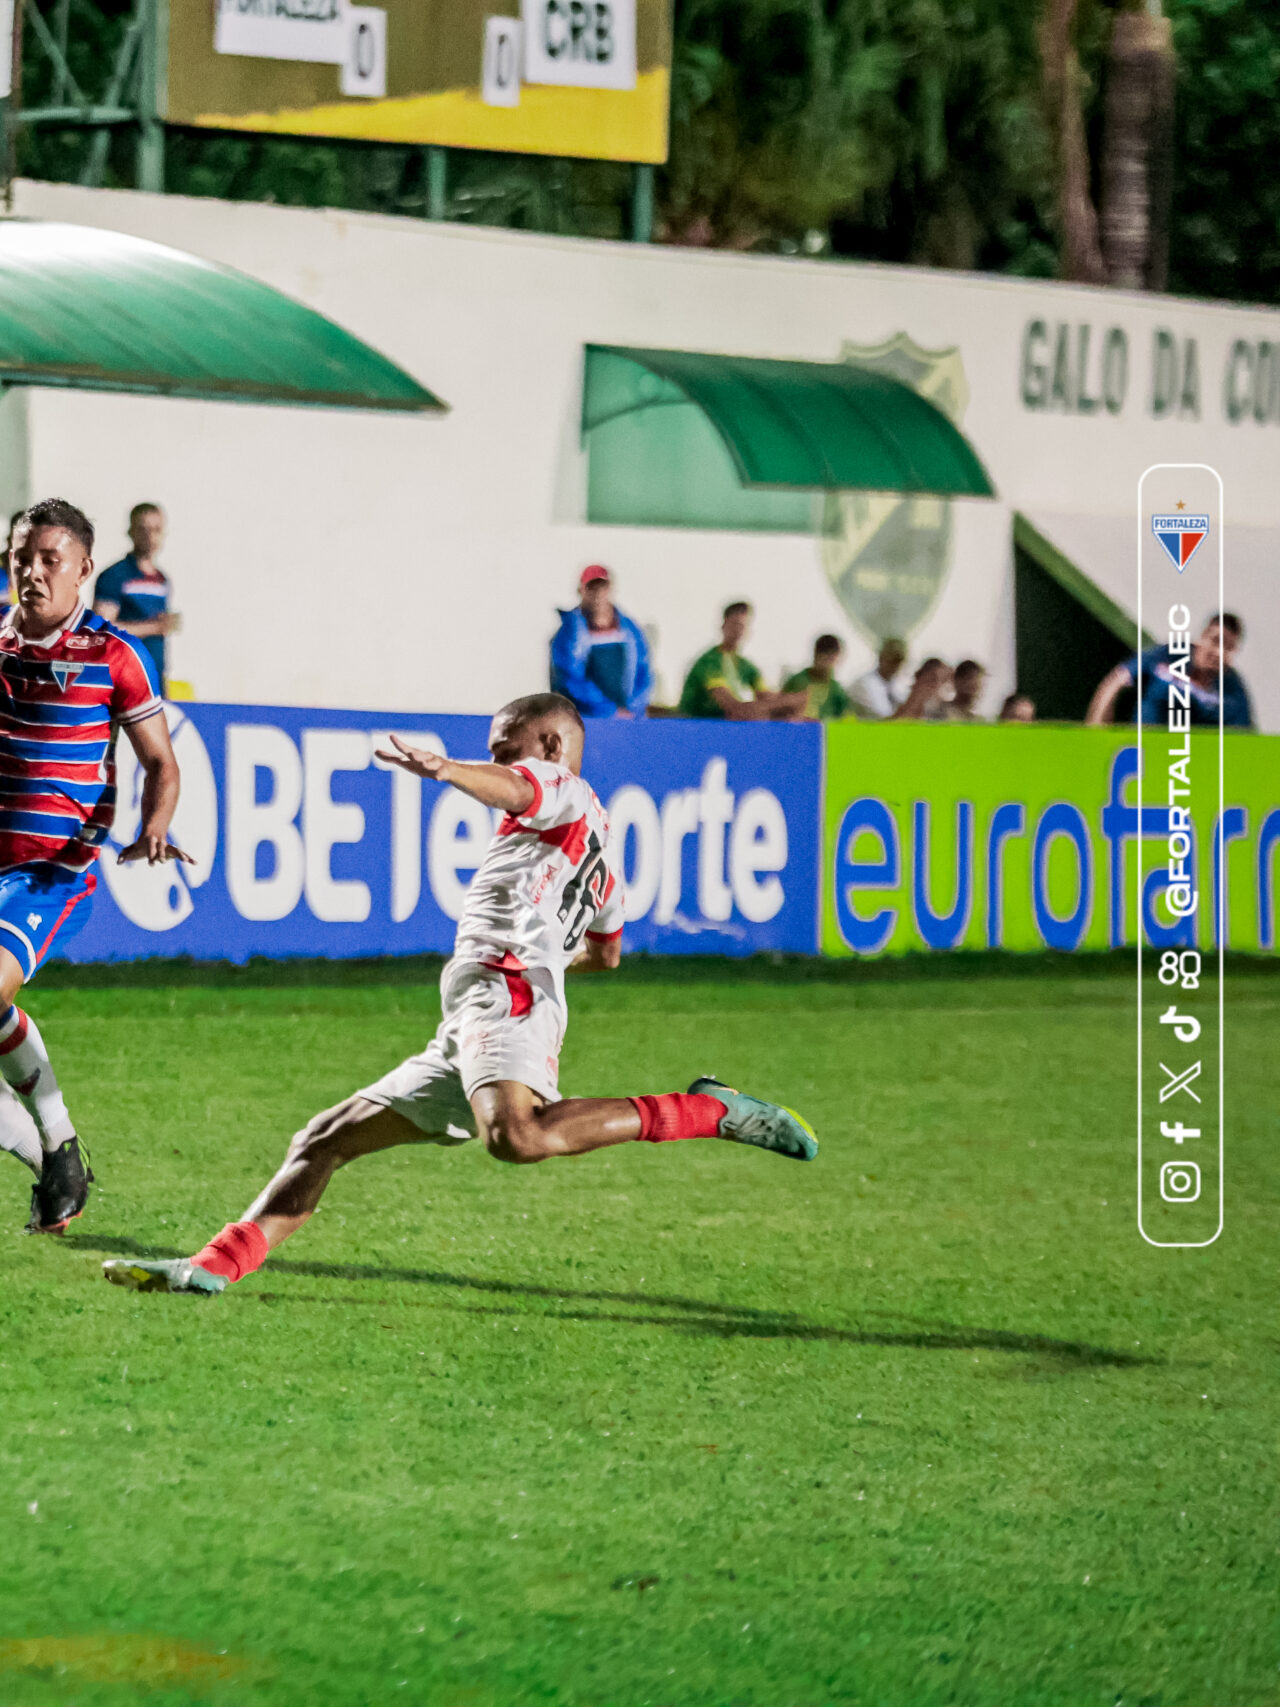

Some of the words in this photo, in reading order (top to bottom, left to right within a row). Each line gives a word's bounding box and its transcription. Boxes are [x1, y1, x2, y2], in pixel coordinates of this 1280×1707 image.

[354, 22, 375, 81] 0
[494, 32, 516, 89] 0
[543, 0, 613, 63] CRB
[1022, 318, 1129, 416] GALO
[1152, 326, 1201, 422] DA
